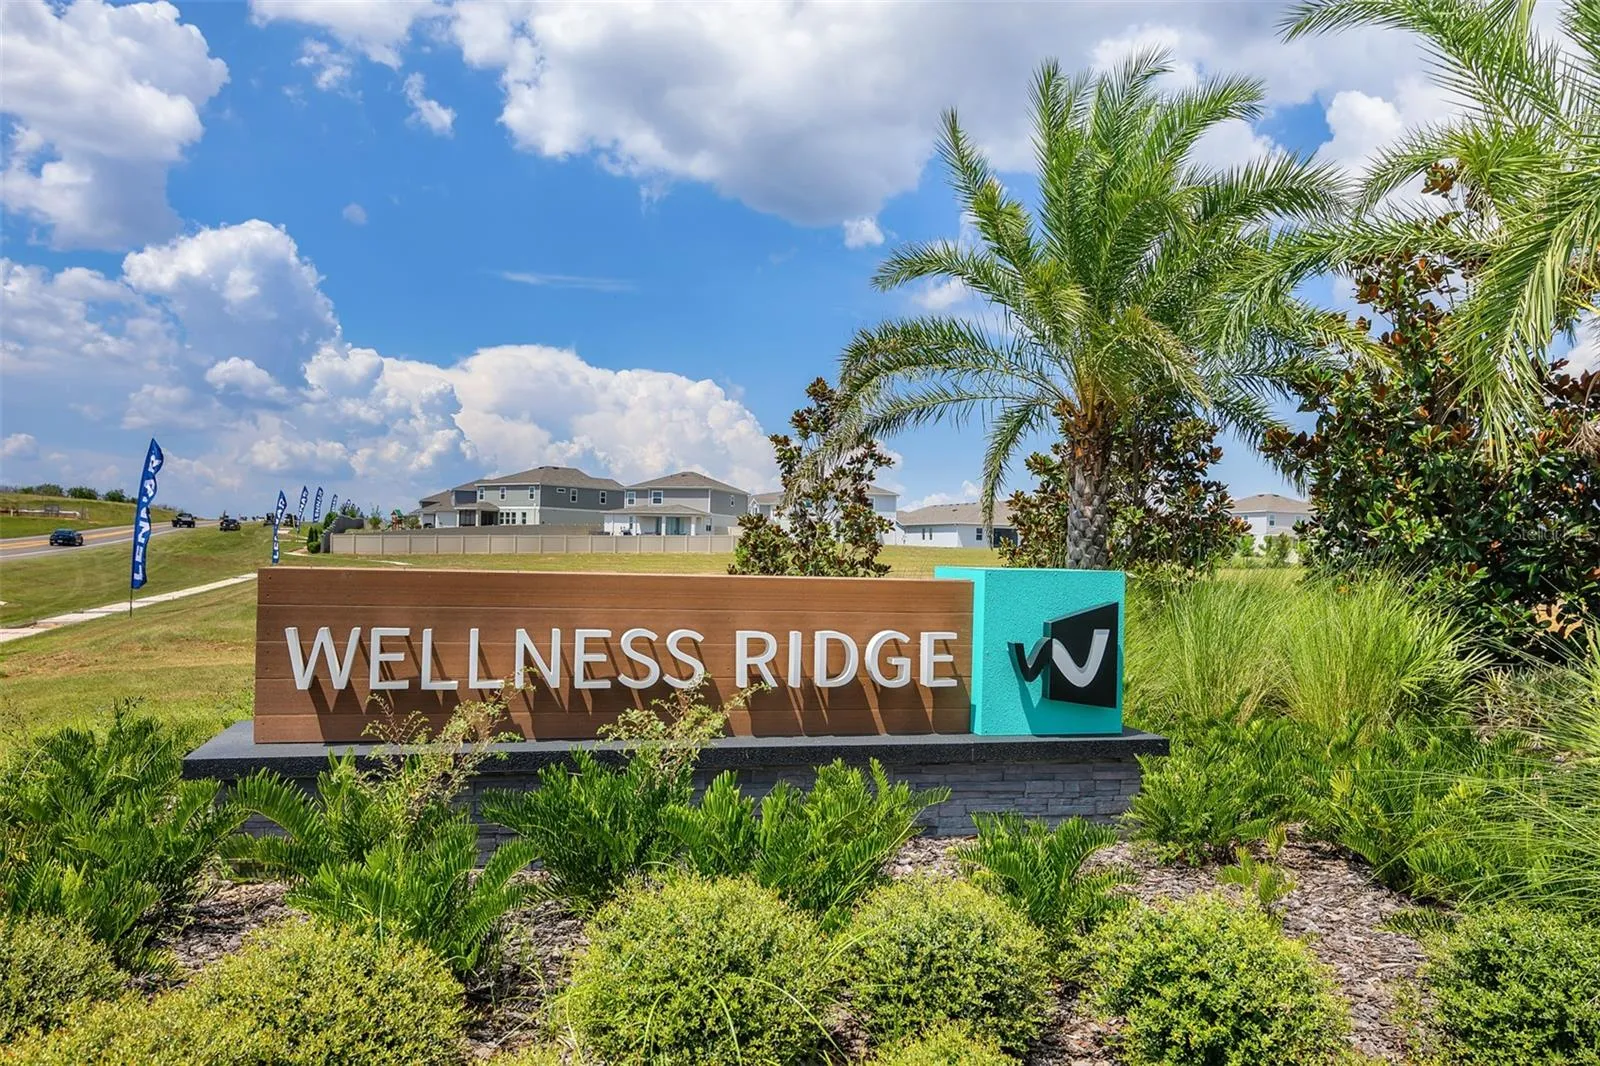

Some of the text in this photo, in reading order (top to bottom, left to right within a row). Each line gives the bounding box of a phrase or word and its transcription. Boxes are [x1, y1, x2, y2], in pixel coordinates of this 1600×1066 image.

[273, 498, 286, 559] LEAR
[285, 626, 959, 690] WELLNESS RIDGE
